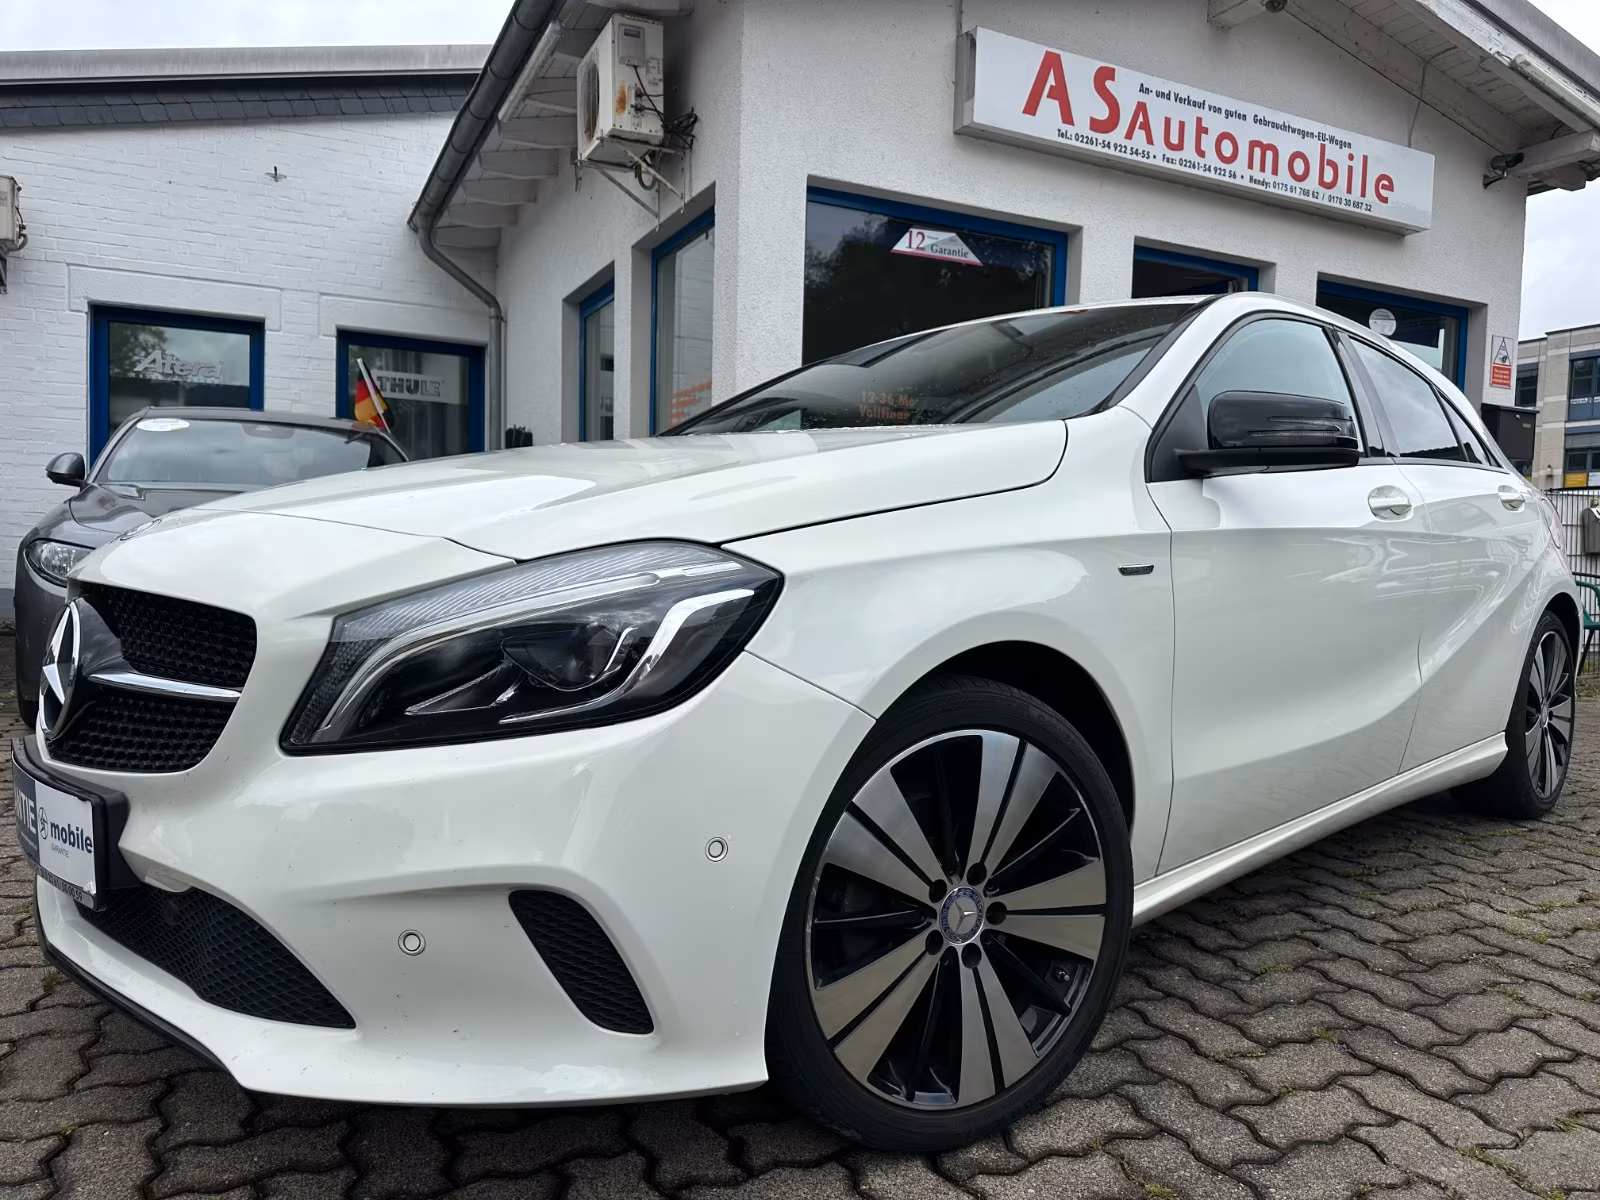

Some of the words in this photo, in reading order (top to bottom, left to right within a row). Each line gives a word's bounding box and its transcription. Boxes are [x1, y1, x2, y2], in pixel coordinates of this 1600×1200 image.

[1138, 83, 1153, 95] An-
[1155, 90, 1171, 101] und
[1173, 92, 1206, 110] Verkauf
[1208, 104, 1222, 115] von
[1224, 109, 1247, 121] guten
[1057, 129, 1073, 140] Tel.:
[1074, 133, 1111, 149] 02261-54
[1113, 143, 1128, 154] 922
[1129, 147, 1150, 159] 54-55
[1162, 153, 1177, 165] Fax:
[1178, 158, 1212, 173] 02261-54
[1213, 166, 1227, 177] 922
[1228, 170, 1237, 179] 56
[1249, 175, 1271, 189] Handy:
[1272, 181, 1288, 193] 0175
[1289, 184, 1297, 194] 61
[1299, 187, 1311, 198] 768
[1311, 191, 1319, 200] 62
[1328, 194, 1342, 205] 0170
[1344, 198, 1351, 207] 30
[1352, 200, 1364, 209] 687
[1364, 203, 1372, 212] 32
[906, 230, 925, 251] 12
[930, 243, 969, 258] Garantie
[377, 376, 441, 397] THULE
[50, 821, 93, 854] mobile
